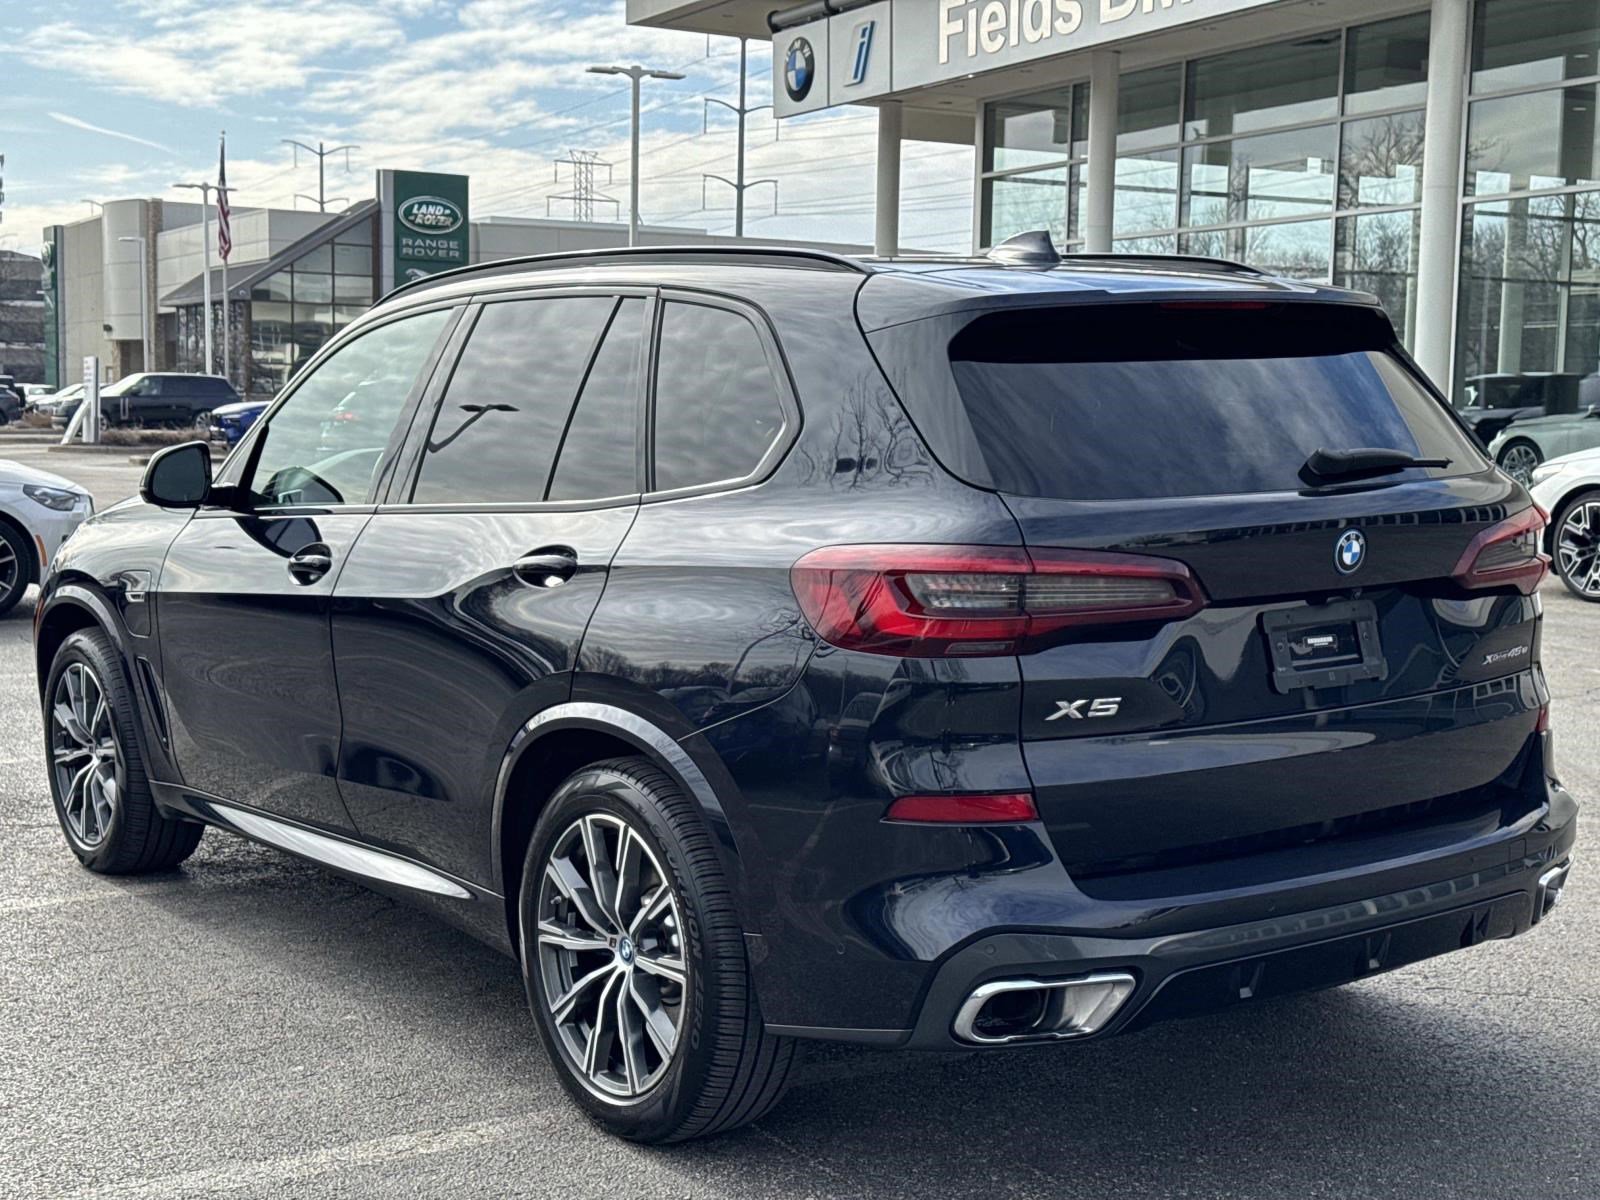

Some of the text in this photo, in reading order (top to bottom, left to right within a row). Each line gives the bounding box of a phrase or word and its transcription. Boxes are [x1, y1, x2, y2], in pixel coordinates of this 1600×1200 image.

[938, 0, 1083, 64] Fields
[412, 204, 442, 215] LAND
[415, 214, 453, 226] ROVER
[402, 238, 459, 249] RANGE
[402, 248, 460, 258] ROVER
[1044, 697, 1122, 720] X5
